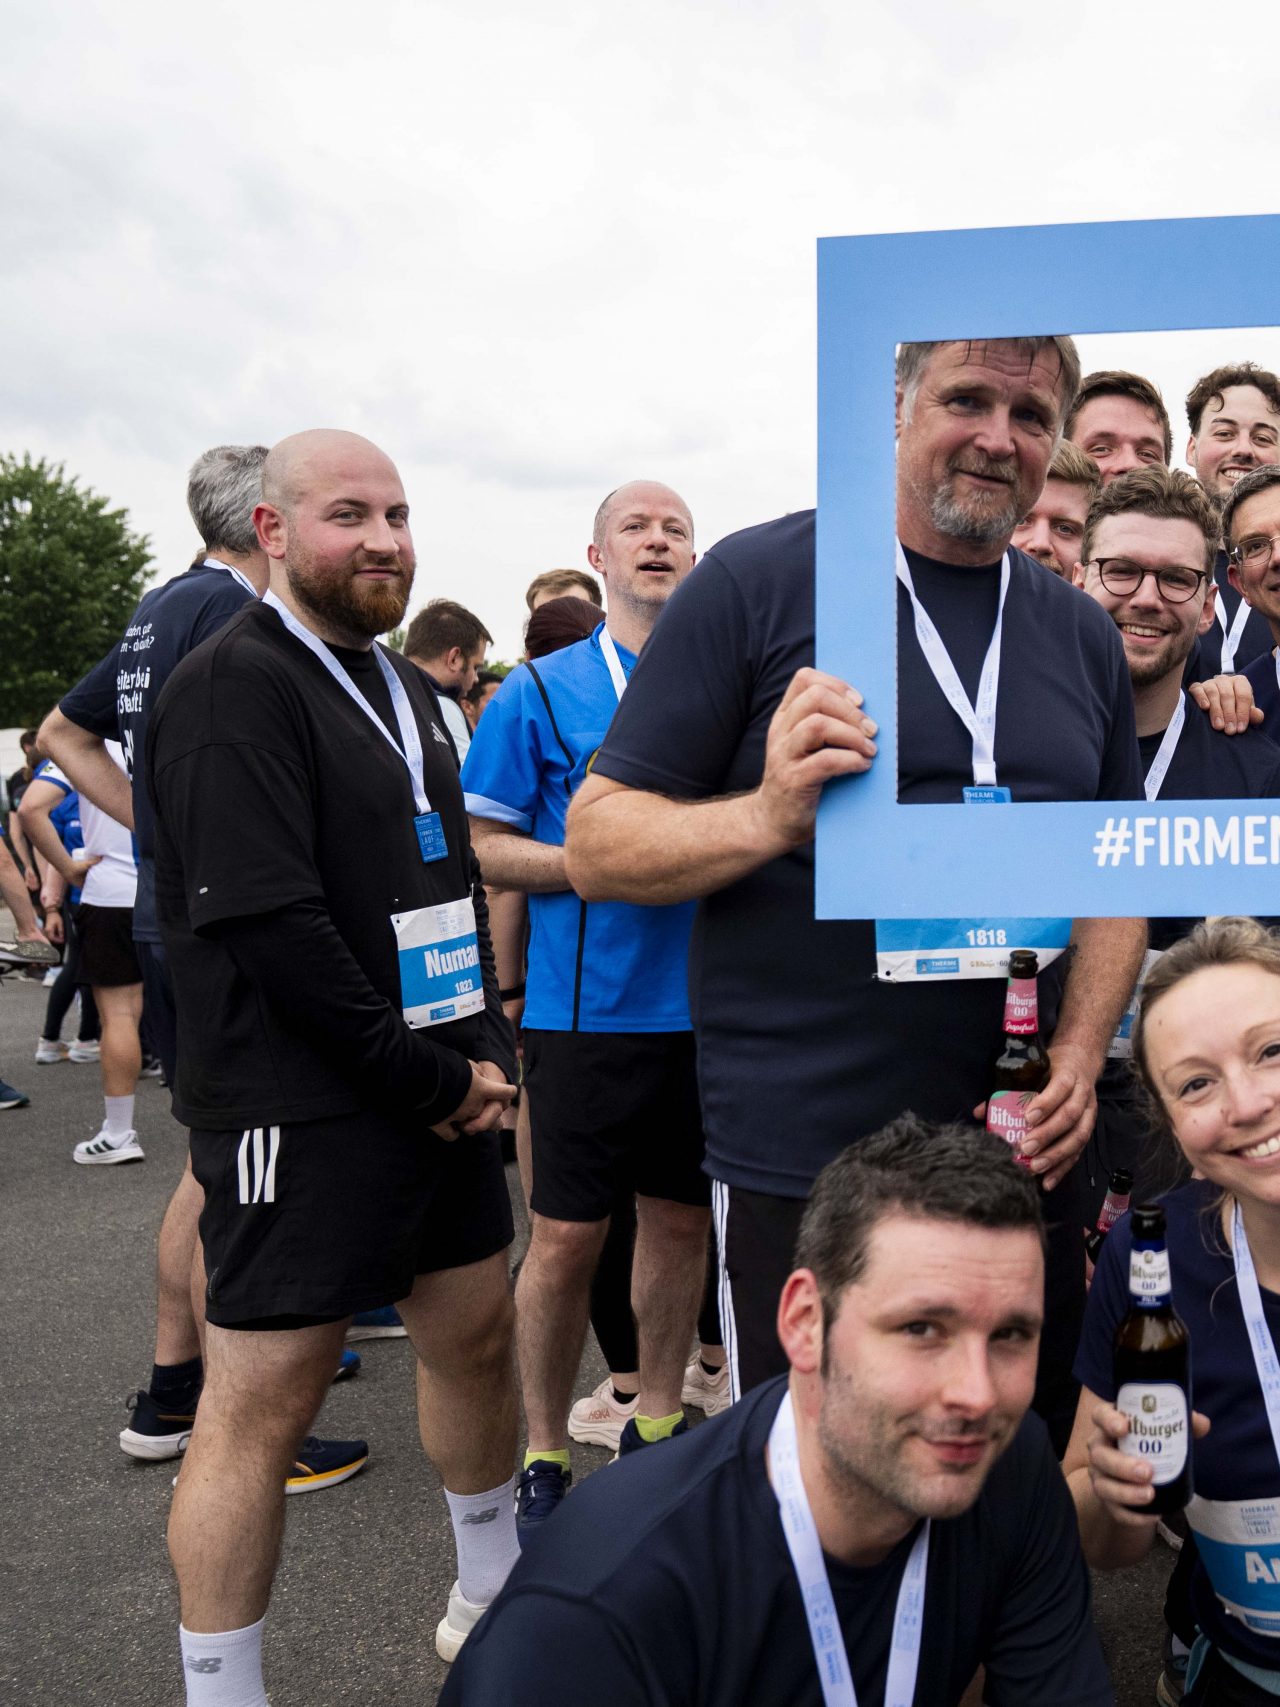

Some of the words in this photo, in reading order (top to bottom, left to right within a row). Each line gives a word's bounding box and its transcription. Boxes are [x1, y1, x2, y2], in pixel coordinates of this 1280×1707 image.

[966, 929, 1007, 946] 1818
[424, 944, 480, 978] Numan
[455, 979, 473, 994] 1823
[1127, 1413, 1184, 1438] itburger
